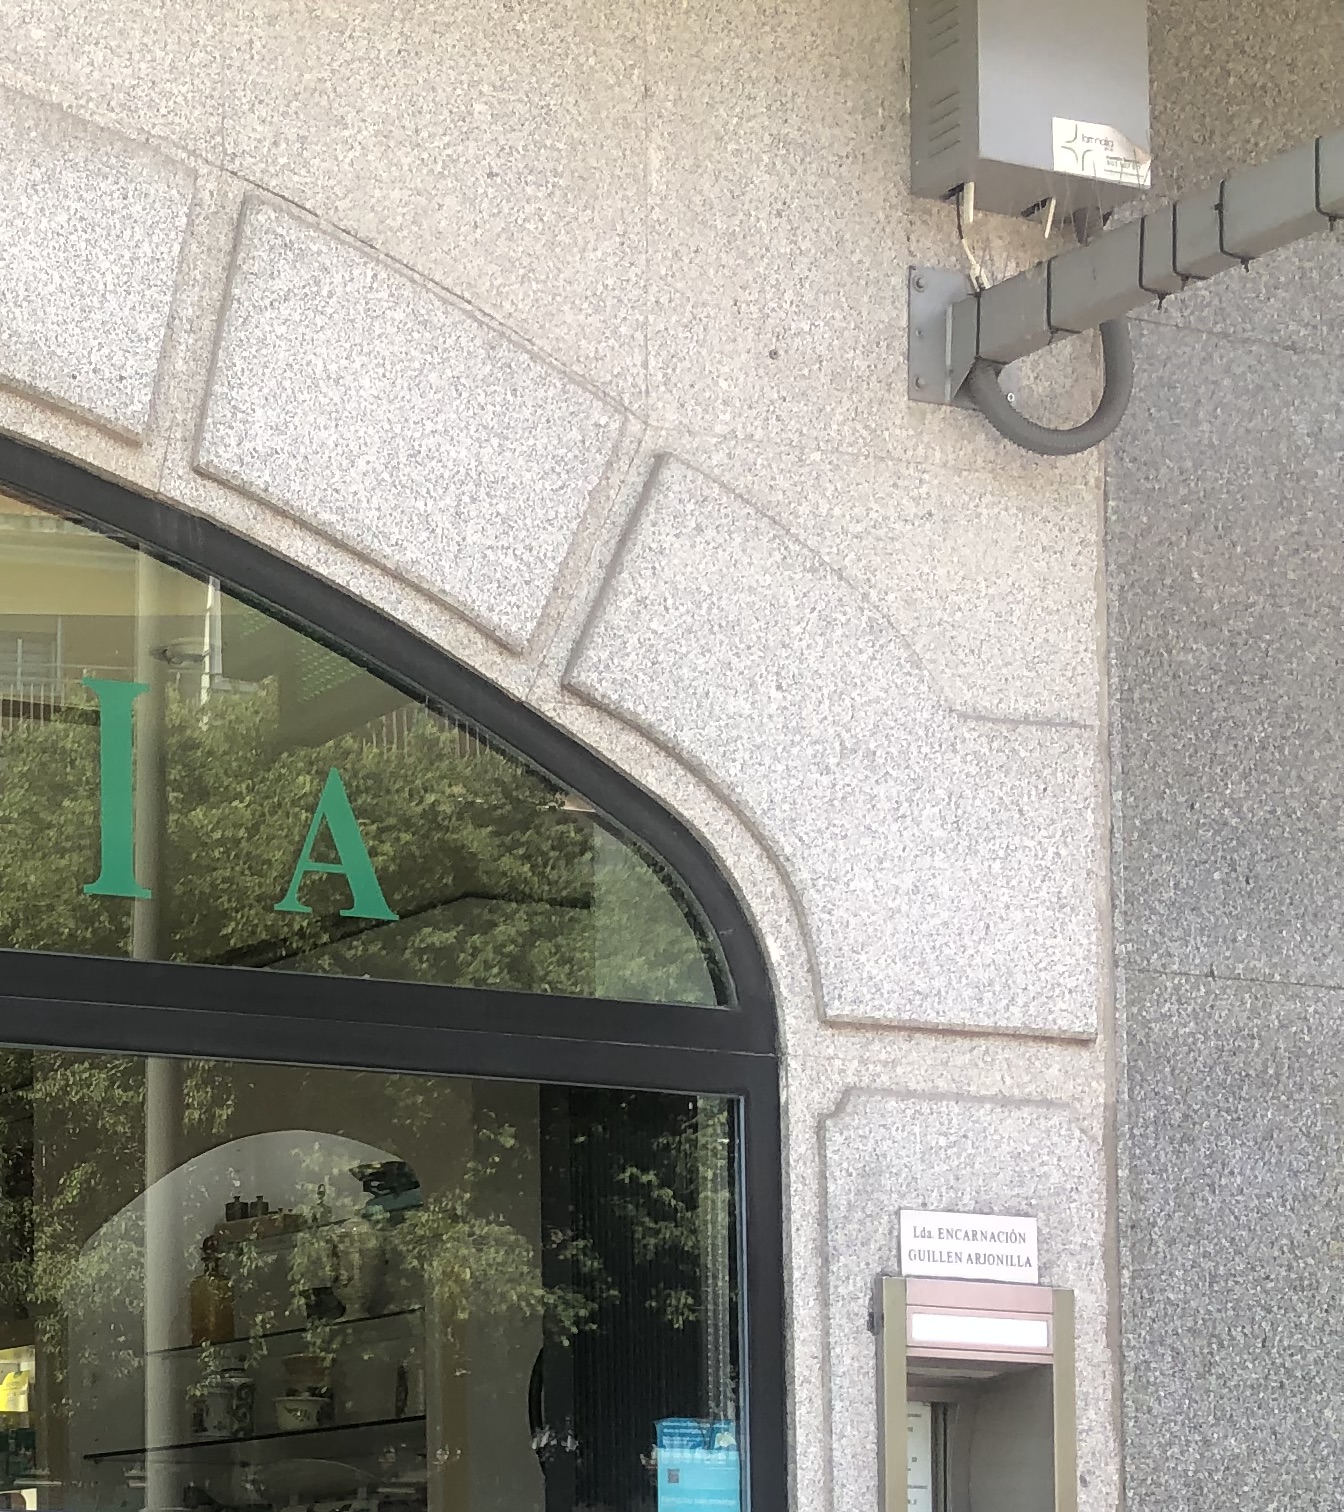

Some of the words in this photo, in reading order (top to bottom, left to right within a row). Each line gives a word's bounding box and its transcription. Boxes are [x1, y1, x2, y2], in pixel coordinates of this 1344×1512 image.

[937, 1227, 1027, 1245] ENCARNACIÓN
[908, 1248, 963, 1264] GUILLEN
[965, 1251, 1033, 1268] ARJONILLA
